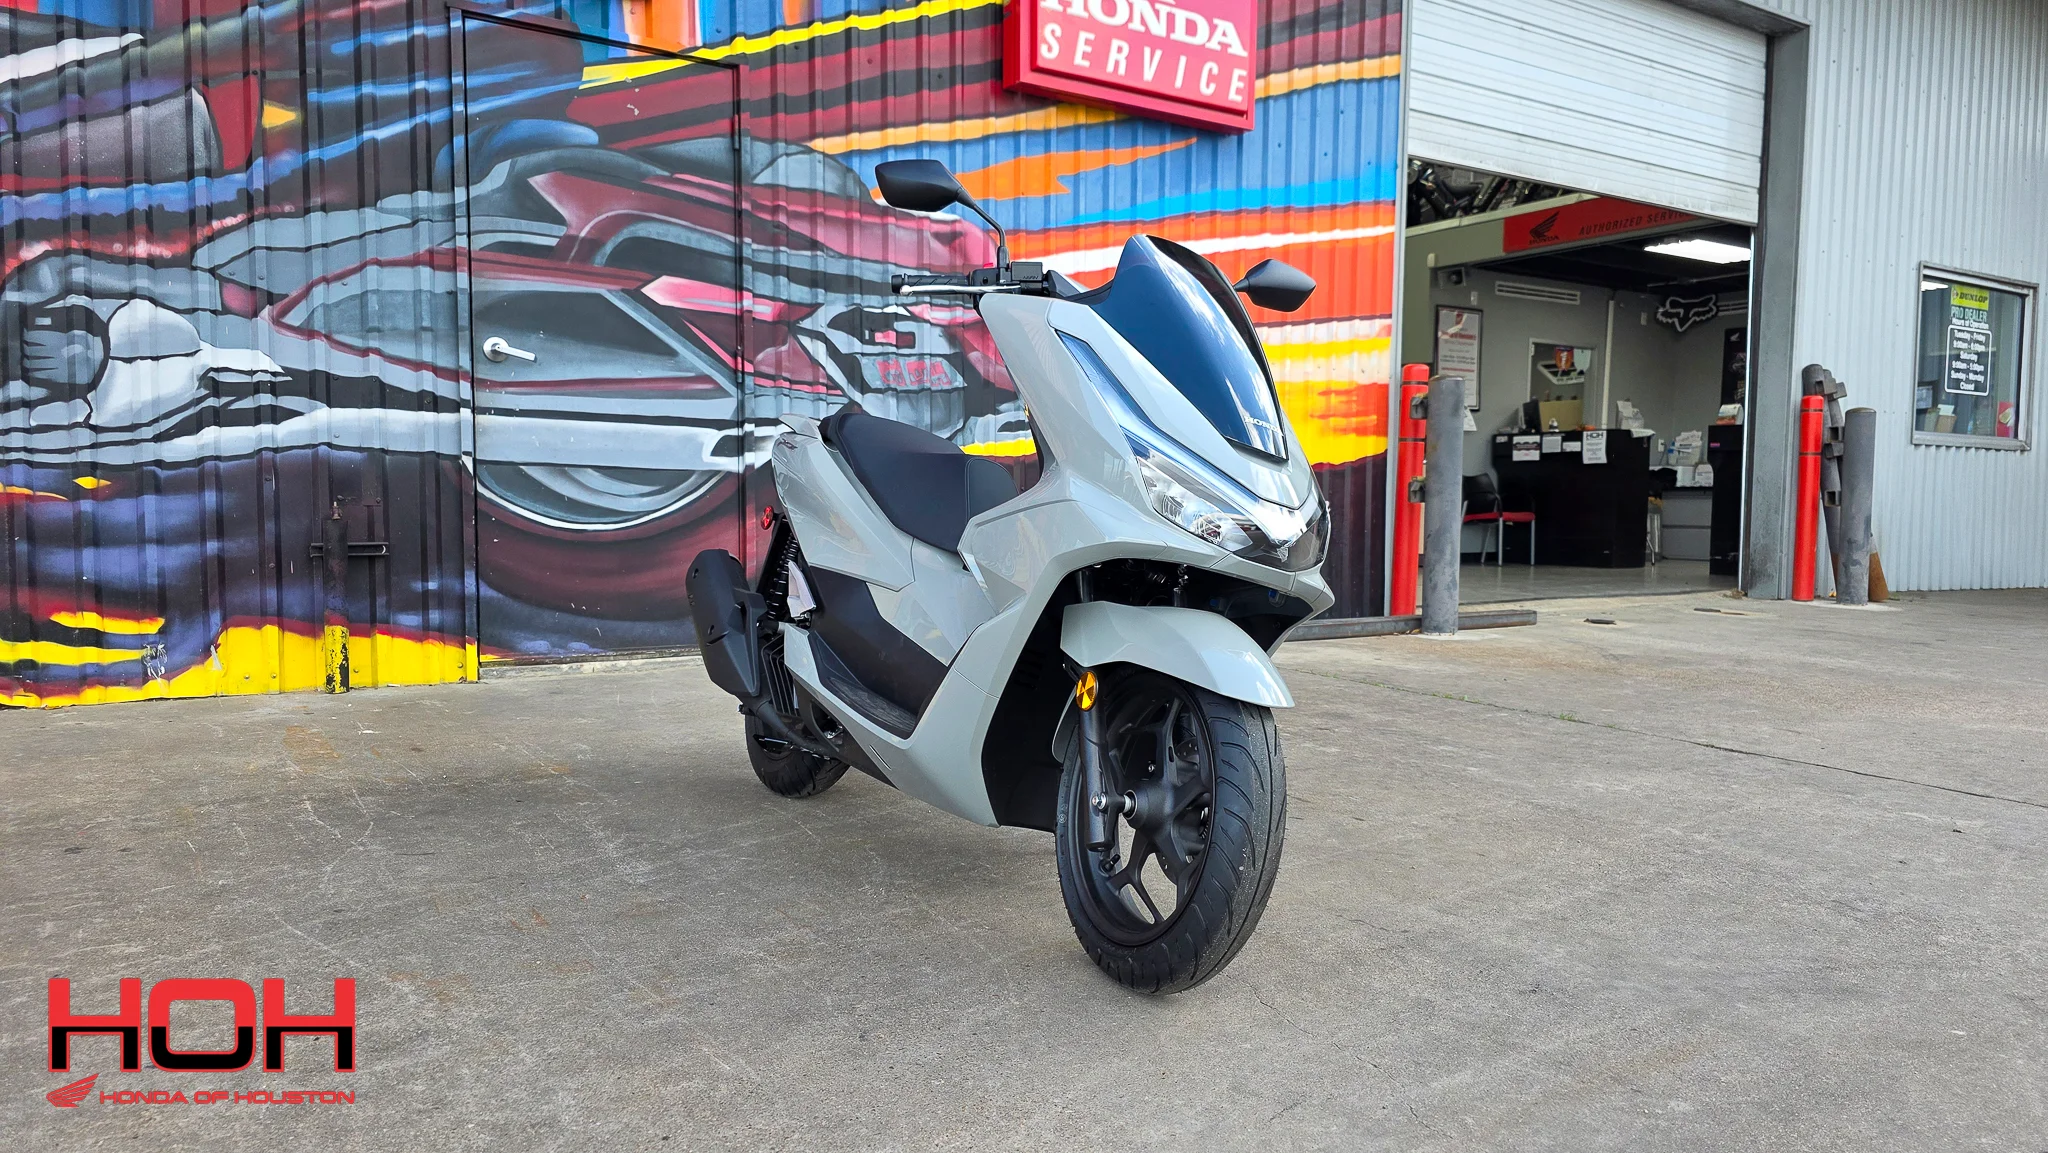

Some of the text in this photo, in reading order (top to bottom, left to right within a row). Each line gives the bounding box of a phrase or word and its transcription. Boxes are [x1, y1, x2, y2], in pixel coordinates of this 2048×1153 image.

[1040, 23, 1248, 103] SERVICE
[1579, 217, 1642, 235] AUTHORIZED
[1959, 292, 1988, 303] DUNLOP
[1951, 306, 1987, 322] PRO DEALER
[1952, 318, 1964, 326] Hours
[1970, 319, 1989, 330] Operation
[1960, 381, 1975, 391] Closed
